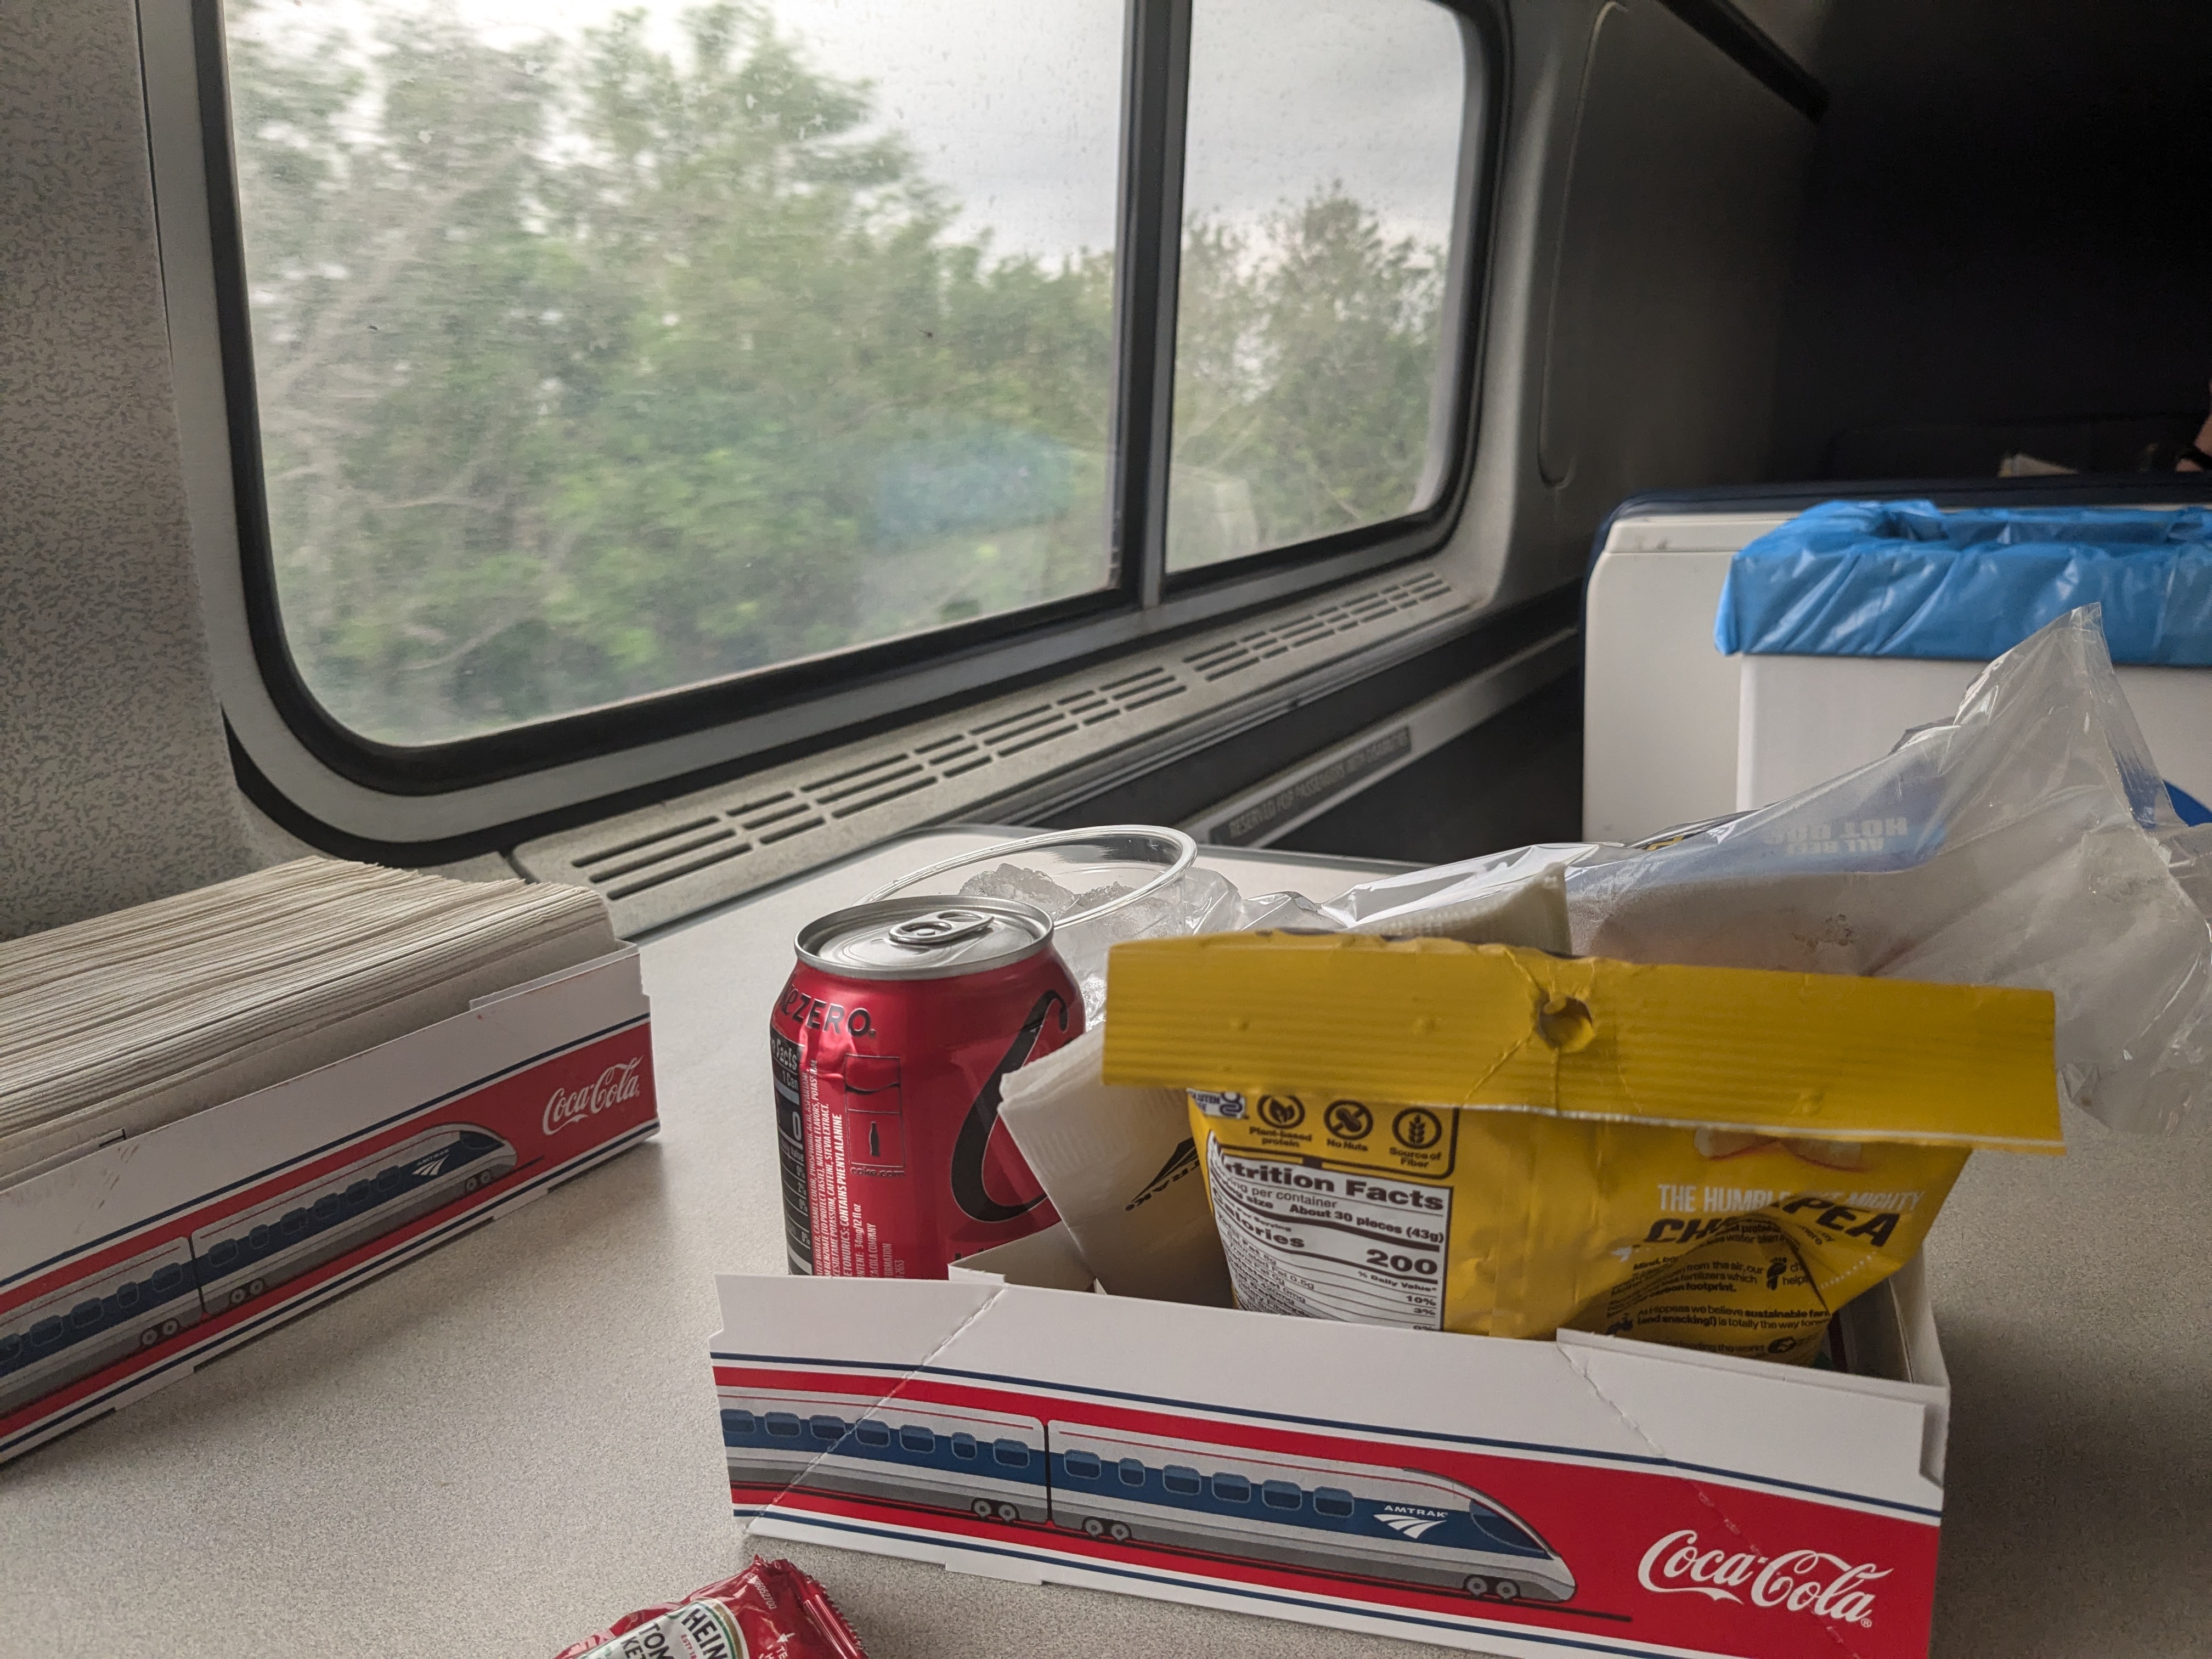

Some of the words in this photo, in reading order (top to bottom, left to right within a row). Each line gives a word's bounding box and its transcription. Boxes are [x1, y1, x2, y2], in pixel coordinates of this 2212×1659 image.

[777, 1038, 797, 1070] Facts
[543, 1055, 644, 1135] Coca-Cola
[787, 1072, 798, 1090] Can
[812, 1102, 821, 1135] FLAVORS,
[820, 1103, 831, 1135] EXTRACT.
[815, 1136, 823, 1166] NATURAL
[823, 1136, 832, 1160] STEVIA
[832, 1113, 847, 1185] PHENYLALANINE
[1327, 1139, 1341, 1148] No
[1343, 1141, 1368, 1153] Nuts
[825, 1161, 834, 1196] CAFFEINE,
[1133, 1159, 1200, 1206] TRAK
[1225, 1162, 1335, 1192] trition
[1345, 1180, 1444, 1210] Facts
[818, 1192, 828, 1223] PROTECT
[837, 1186, 849, 1226] CONTAINS
[1251, 1187, 1273, 1199] per
[1276, 1191, 1338, 1209] container
[1658, 1183, 1696, 1212] THE
[1844, 1189, 1926, 1212] MIGHTY
[811, 1202, 820, 1234] CARAMEL
[827, 1197, 838, 1237] POTASSIUM,
[1289, 1204, 1331, 1218] About
[1334, 1210, 1352, 1223] 30
[1406, 1226, 1444, 1244] (43g)
[822, 1235, 831, 1268] BENZOATE
[840, 1227, 852, 1277] ETONURICS:
[867, 1223, 877, 1252] COMPANY
[830, 1237, 840, 1277] CESULFAME
[1365, 1248, 1438, 1276] 200
[1406, 1295, 1436, 1307] 10%
[1413, 1308, 1436, 1316] 3%
[1707, 1305, 1744, 1317] believe
[1718, 1317, 1728, 1326] is
[1728, 1317, 1759, 1330] totally
[1760, 1318, 1778, 1329] the
[1778, 1320, 1799, 1330] way
[1384, 1504, 1447, 1519] AMTRAK
[1638, 1529, 1894, 1625] Coca-Cola
[637, 1622, 674, 1659] TOM
[681, 1608, 729, 1659] HEIN
